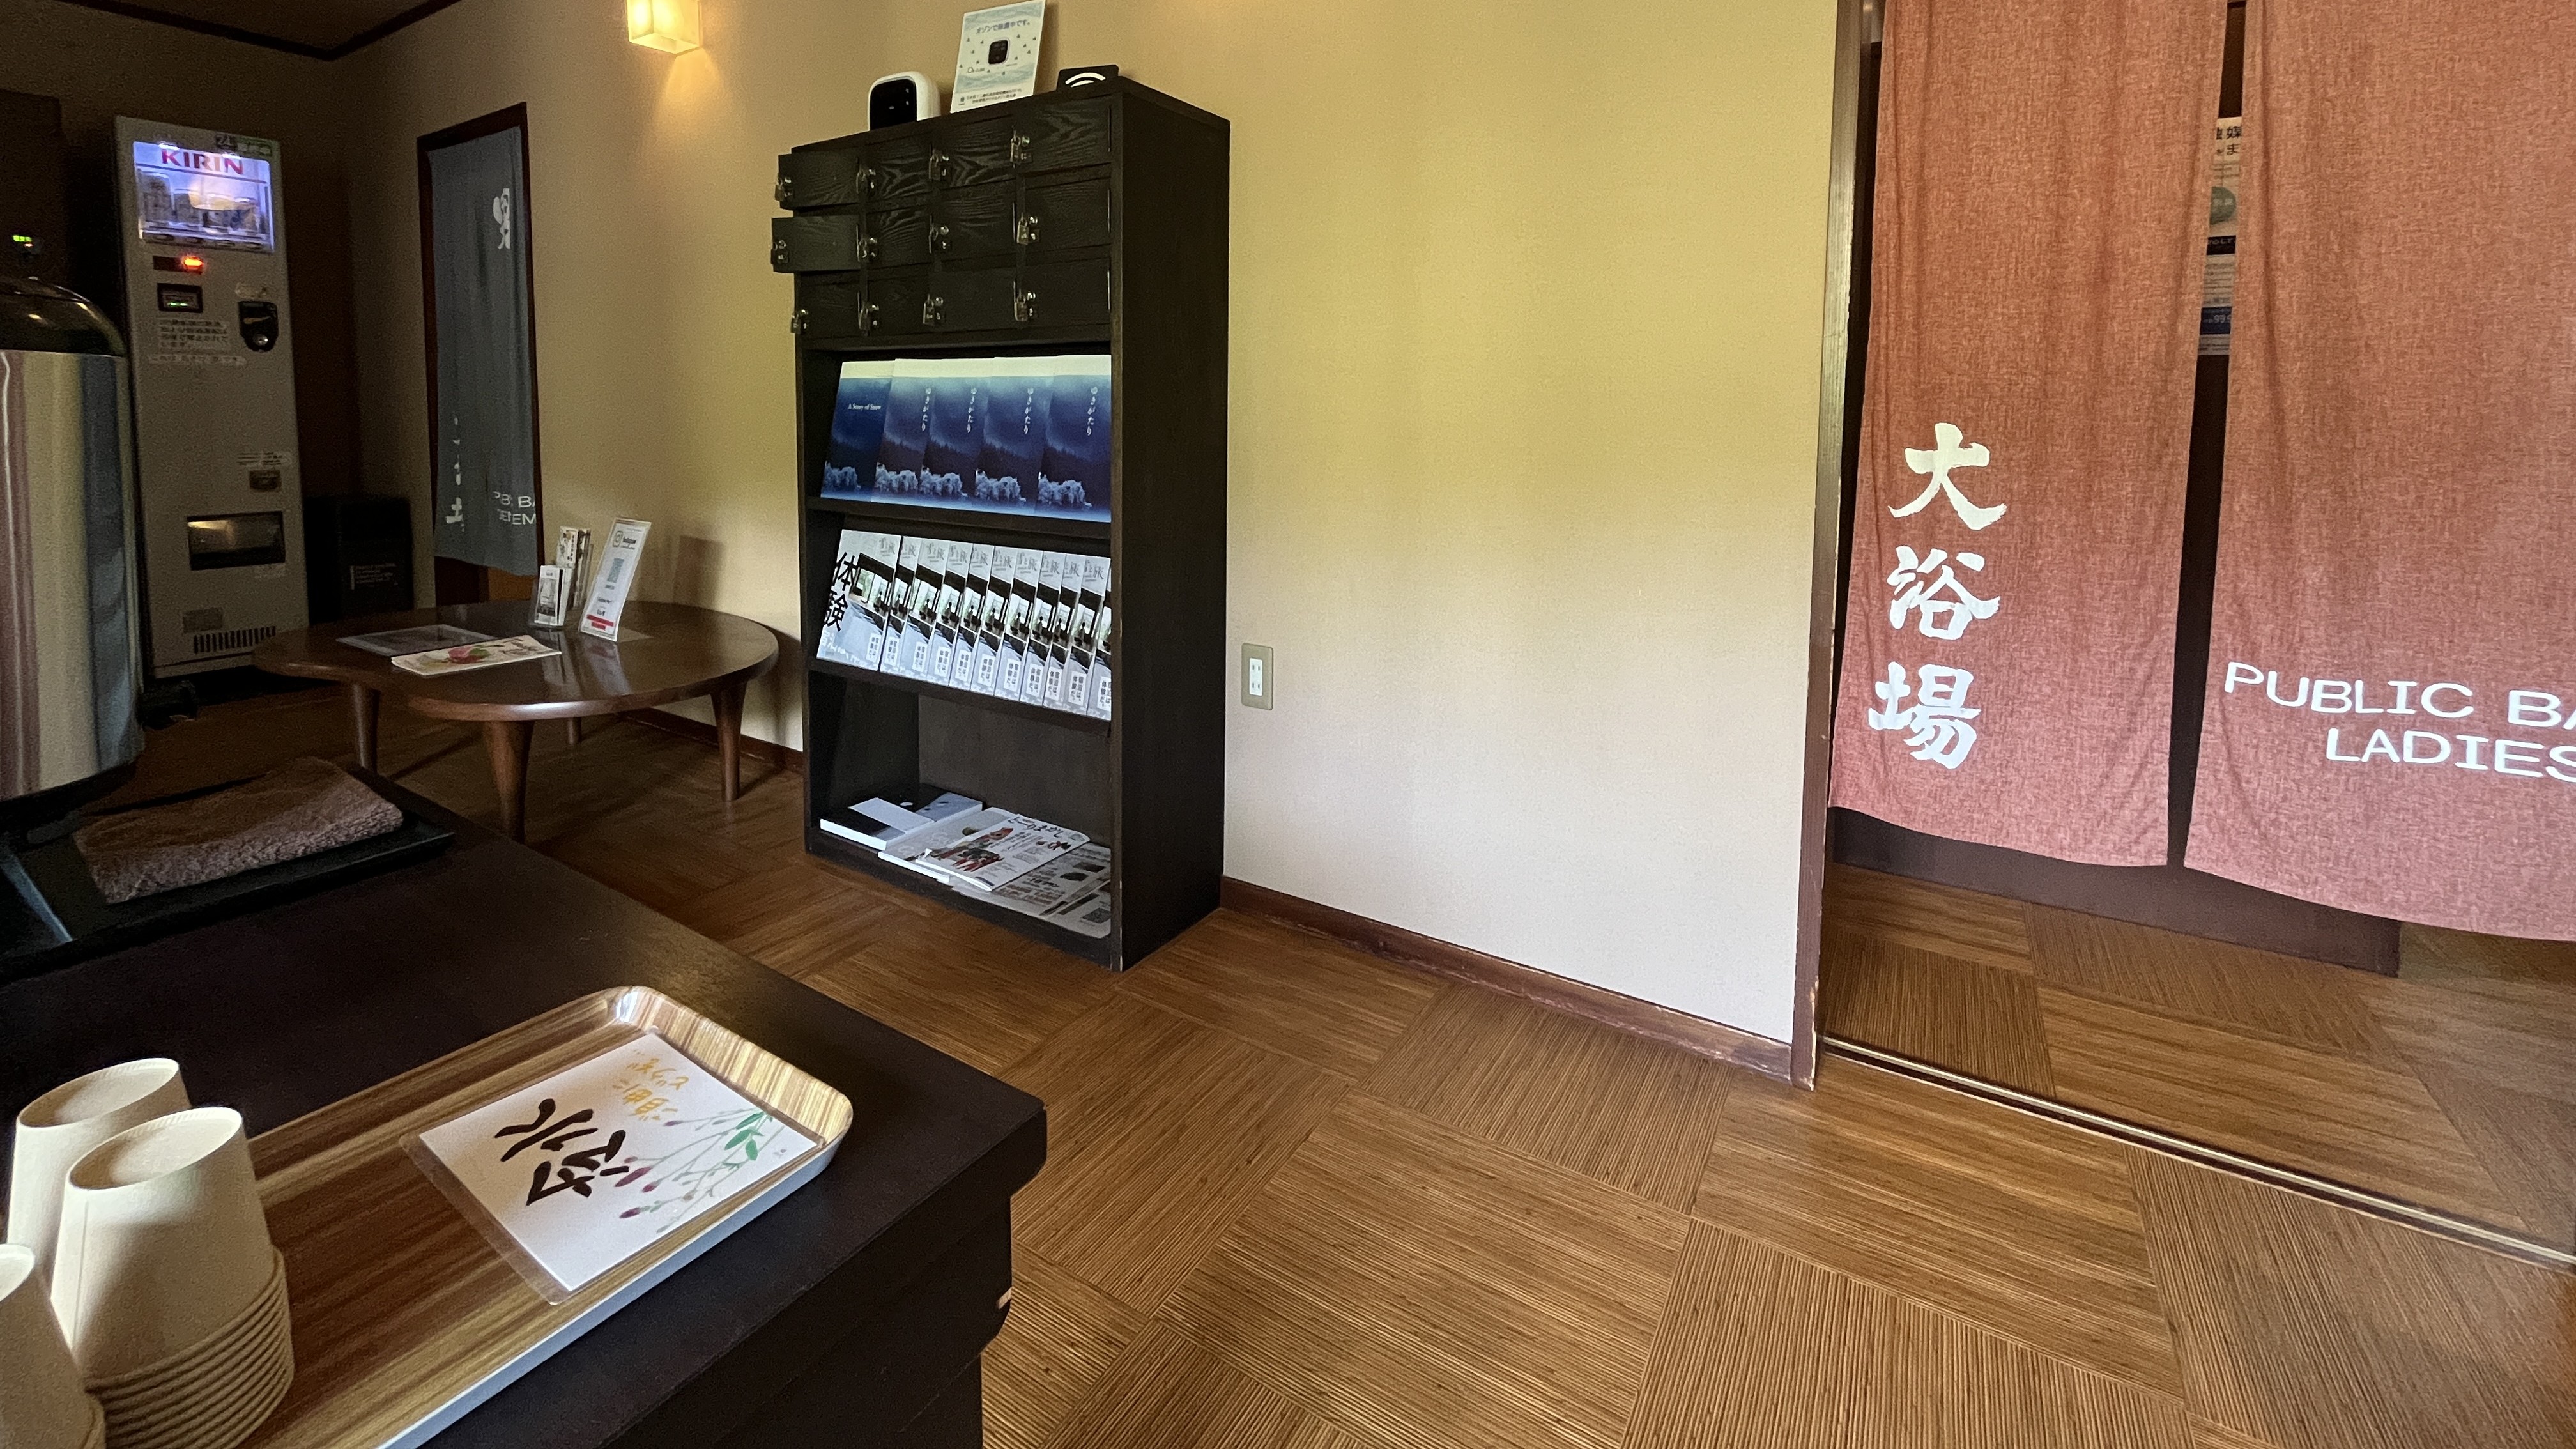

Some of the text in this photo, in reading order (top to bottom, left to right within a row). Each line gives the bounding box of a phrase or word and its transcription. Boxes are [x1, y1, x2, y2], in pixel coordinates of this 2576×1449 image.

[162, 148, 243, 174] KIRIN
[1867, 422, 2007, 770] 大浴場
[2225, 661, 2576, 731] PUBLIC B
[2326, 727, 2576, 783] LADIES
[494, 1098, 630, 1206] 冷水
